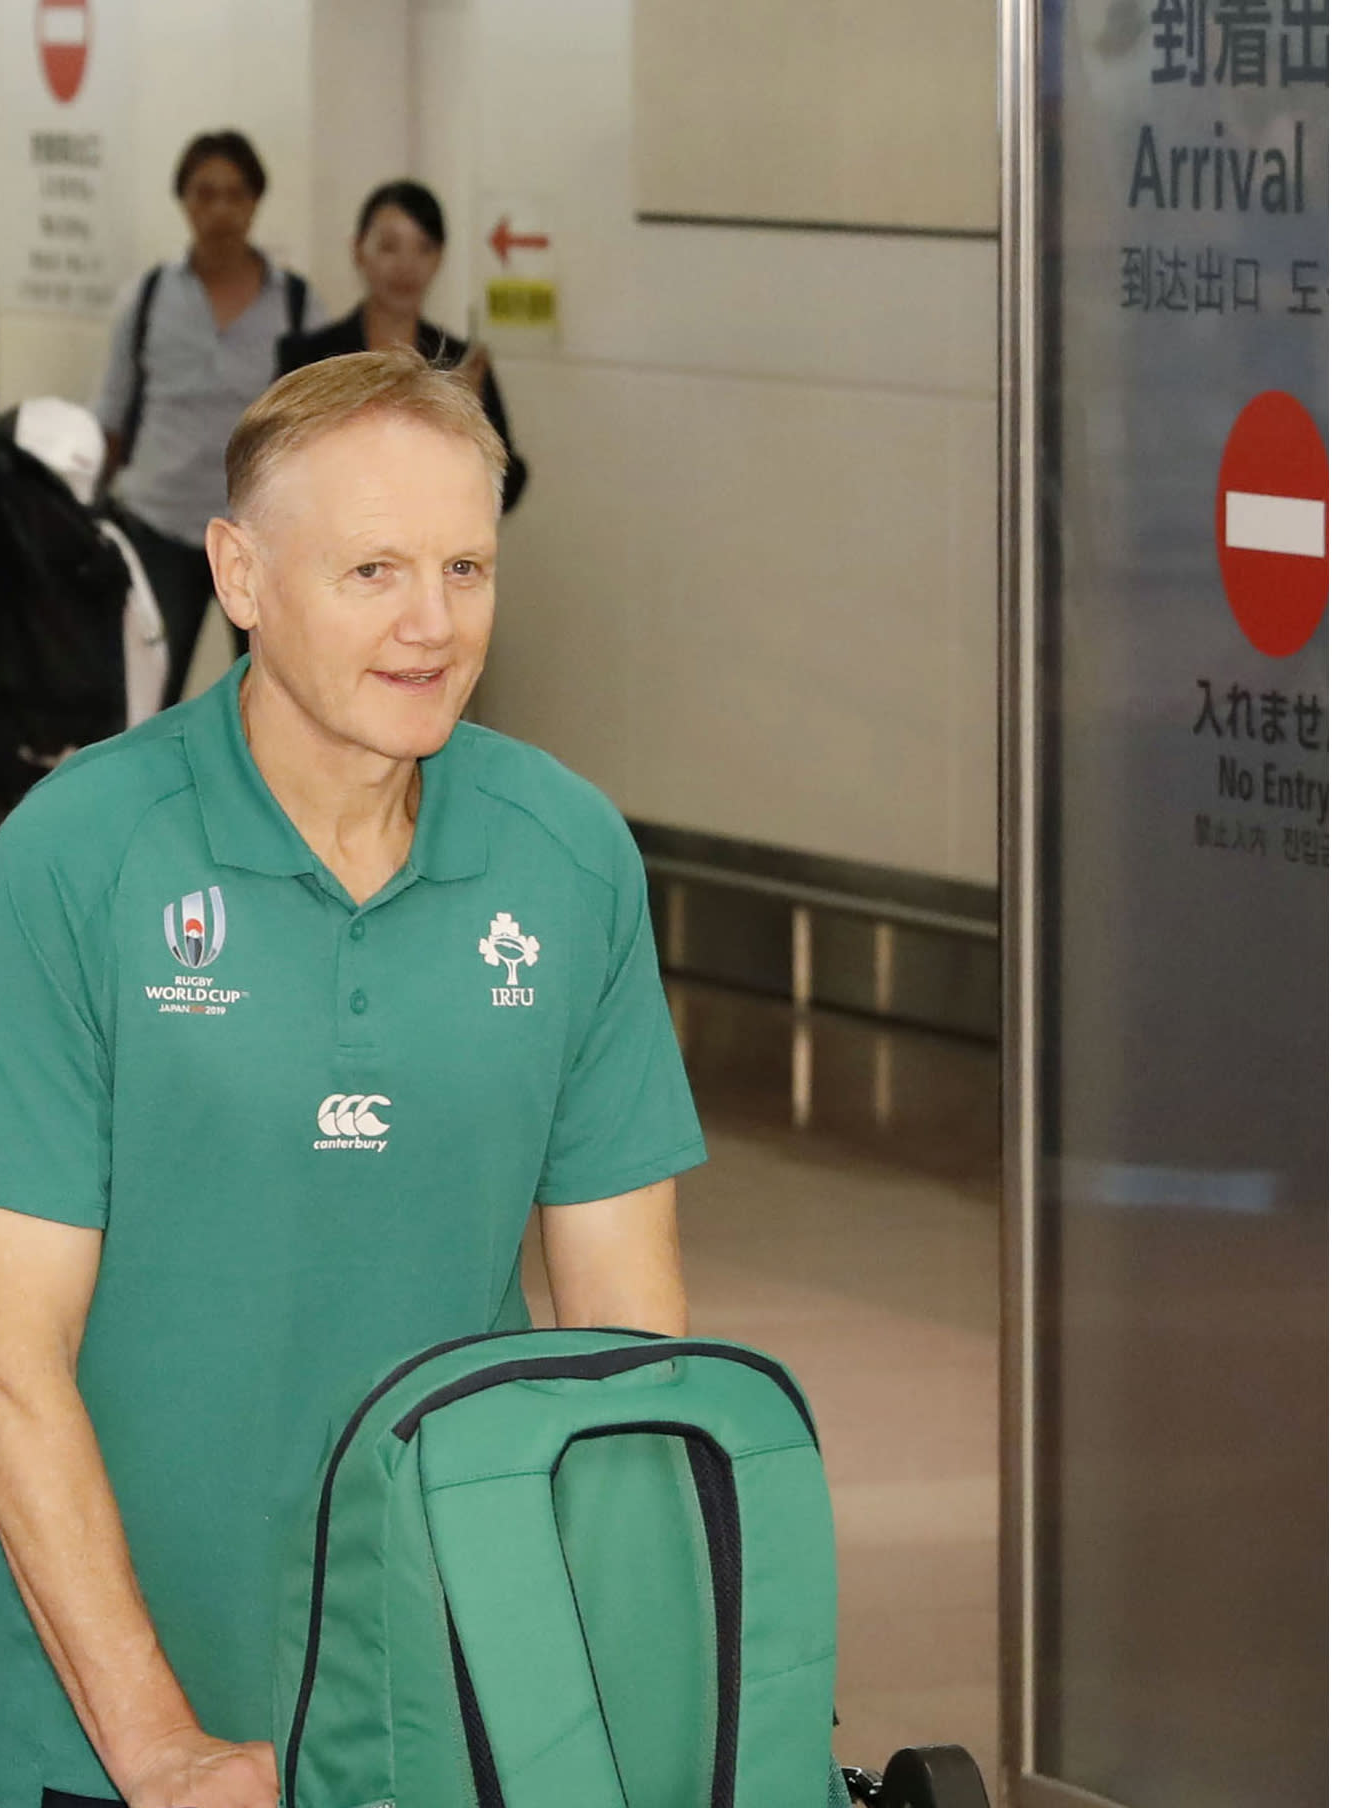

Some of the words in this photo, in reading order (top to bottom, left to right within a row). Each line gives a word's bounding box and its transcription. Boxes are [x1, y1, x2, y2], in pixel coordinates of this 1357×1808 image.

[1127, 120, 1305, 213] Arrival
[1120, 245, 1261, 315] 到达出口
[1193, 679, 1324, 750] 入れませ
[1218, 755, 1253, 802] No
[1262, 761, 1328, 826] Entry
[174, 975, 214, 987] RUGBY
[145, 986, 207, 1001] WORLD
[208, 988, 241, 1003] CUP
[491, 987, 534, 1006] IRFU
[158, 1003, 191, 1013] JAPAN
[205, 1005, 227, 1015] 2019
[312, 1135, 389, 1152] canterbury
